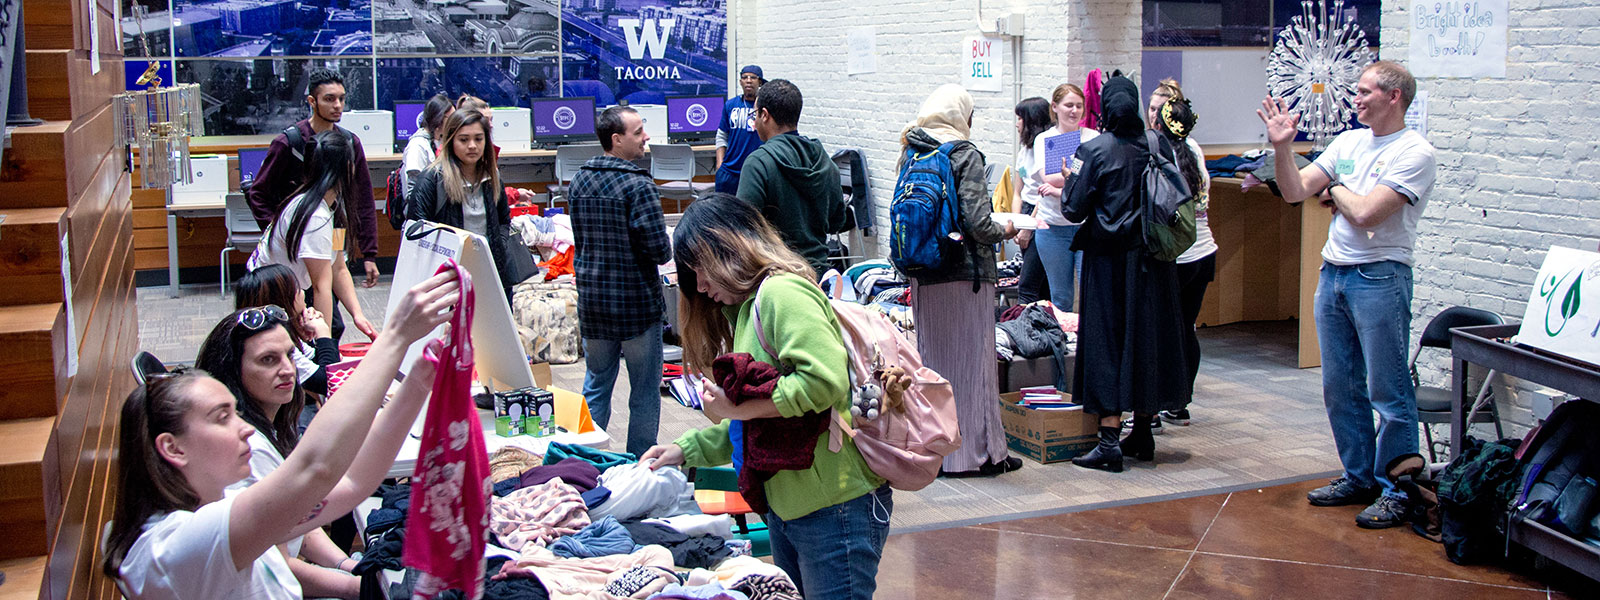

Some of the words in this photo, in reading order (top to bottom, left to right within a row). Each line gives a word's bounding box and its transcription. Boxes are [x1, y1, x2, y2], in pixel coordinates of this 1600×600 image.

[1416, 1, 1460, 37] Bright
[1463, 2, 1493, 28] idea
[618, 19, 676, 59] W
[972, 39, 992, 59] BUY
[1428, 31, 1485, 57] booth!
[614, 66, 681, 79] TACOMA
[971, 61, 993, 78] SELL
